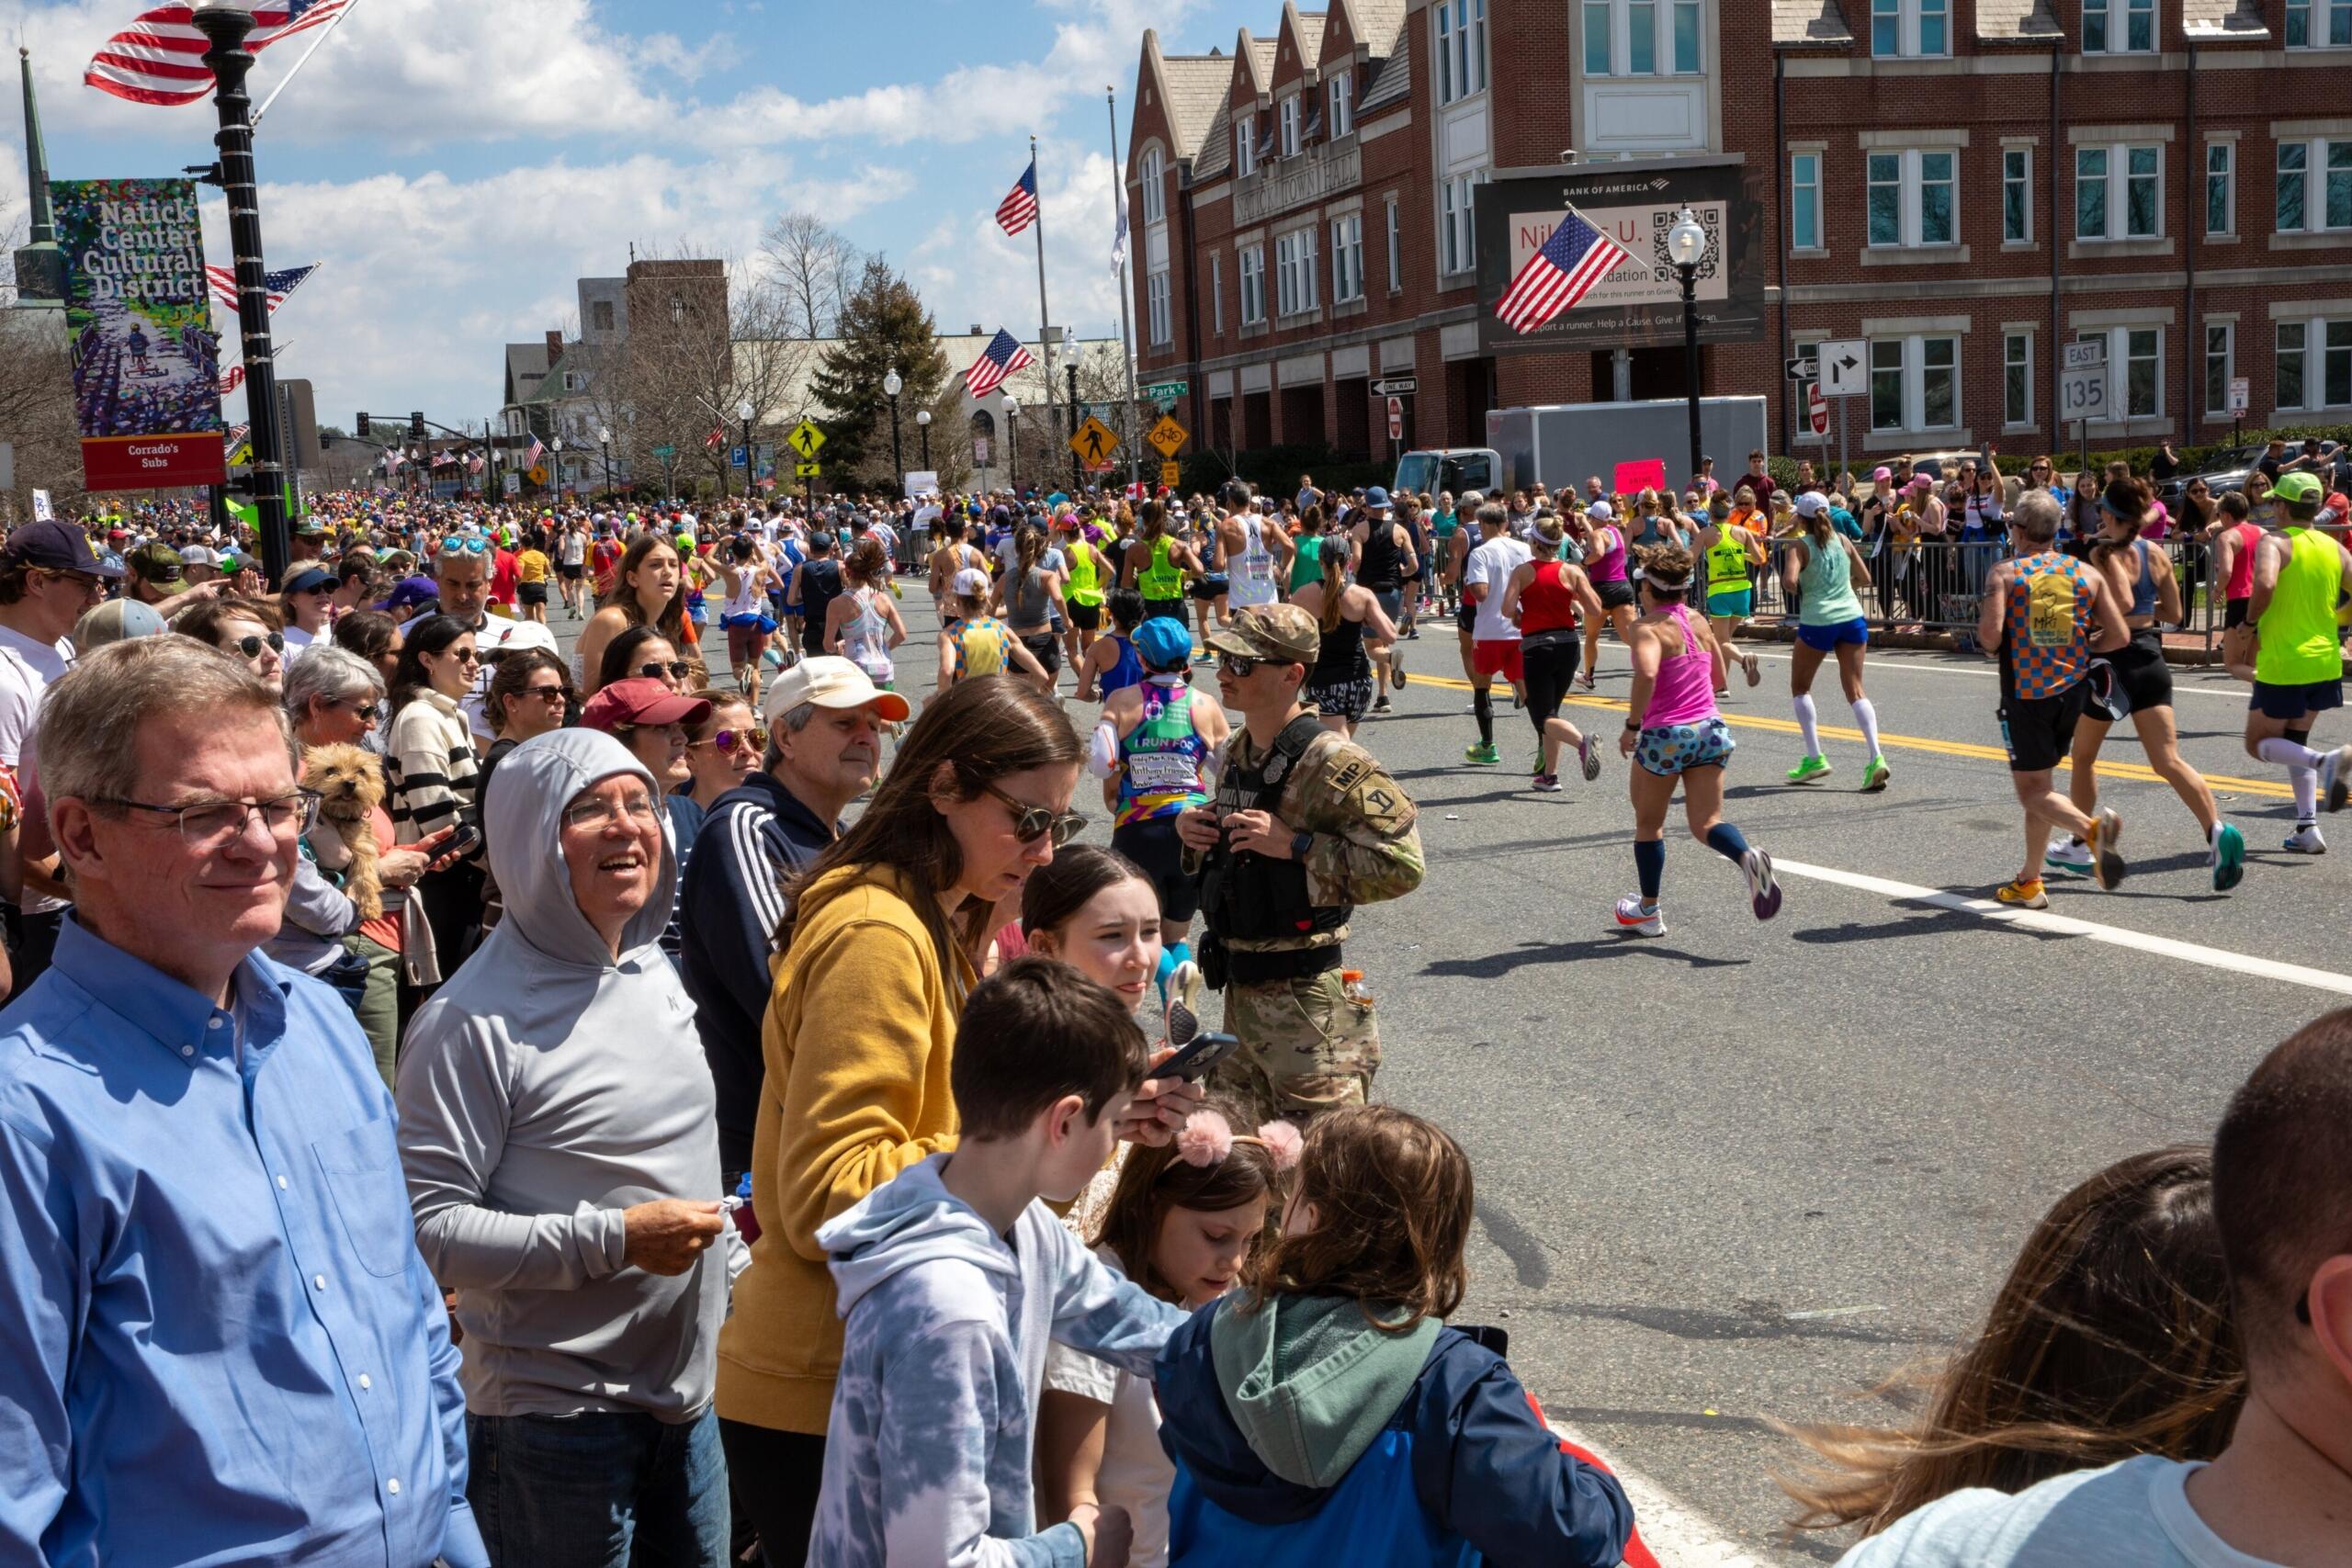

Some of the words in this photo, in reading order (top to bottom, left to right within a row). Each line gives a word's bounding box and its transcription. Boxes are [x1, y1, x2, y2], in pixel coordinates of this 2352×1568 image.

[1237, 186, 1273, 220] NATICK
[1282, 170, 1315, 205] TOWN
[1323, 156, 1357, 190] HALL
[1563, 187, 1589, 196] BANK
[1591, 186, 1603, 194] OF
[1605, 184, 1649, 194] AMERICA
[99, 197, 195, 225] Natick
[101, 226, 197, 250] Center
[1619, 220, 1643, 243] U.
[83, 248, 201, 275] Cultural
[94, 272, 203, 299] District
[1566, 321, 1595, 330] runner.
[1597, 320, 1618, 331] Help
[1625, 318, 1652, 327] Cause.
[1655, 316, 1673, 324] Give
[1675, 315, 1682, 323] if
[2069, 345, 2097, 363] EAST
[1148, 386, 1176, 397] Park
[1384, 382, 1396, 390] ONE
[2064, 378, 2103, 409] 135
[128, 444, 179, 456] Corrado's
[734, 448, 743, 461] P
[141, 457, 168, 468] Subs
[1244, 555, 1269, 563] ATHENS
[1134, 739, 1138, 748] I
[1142, 738, 1170, 748] RUN
[1335, 762, 1360, 787] MP
